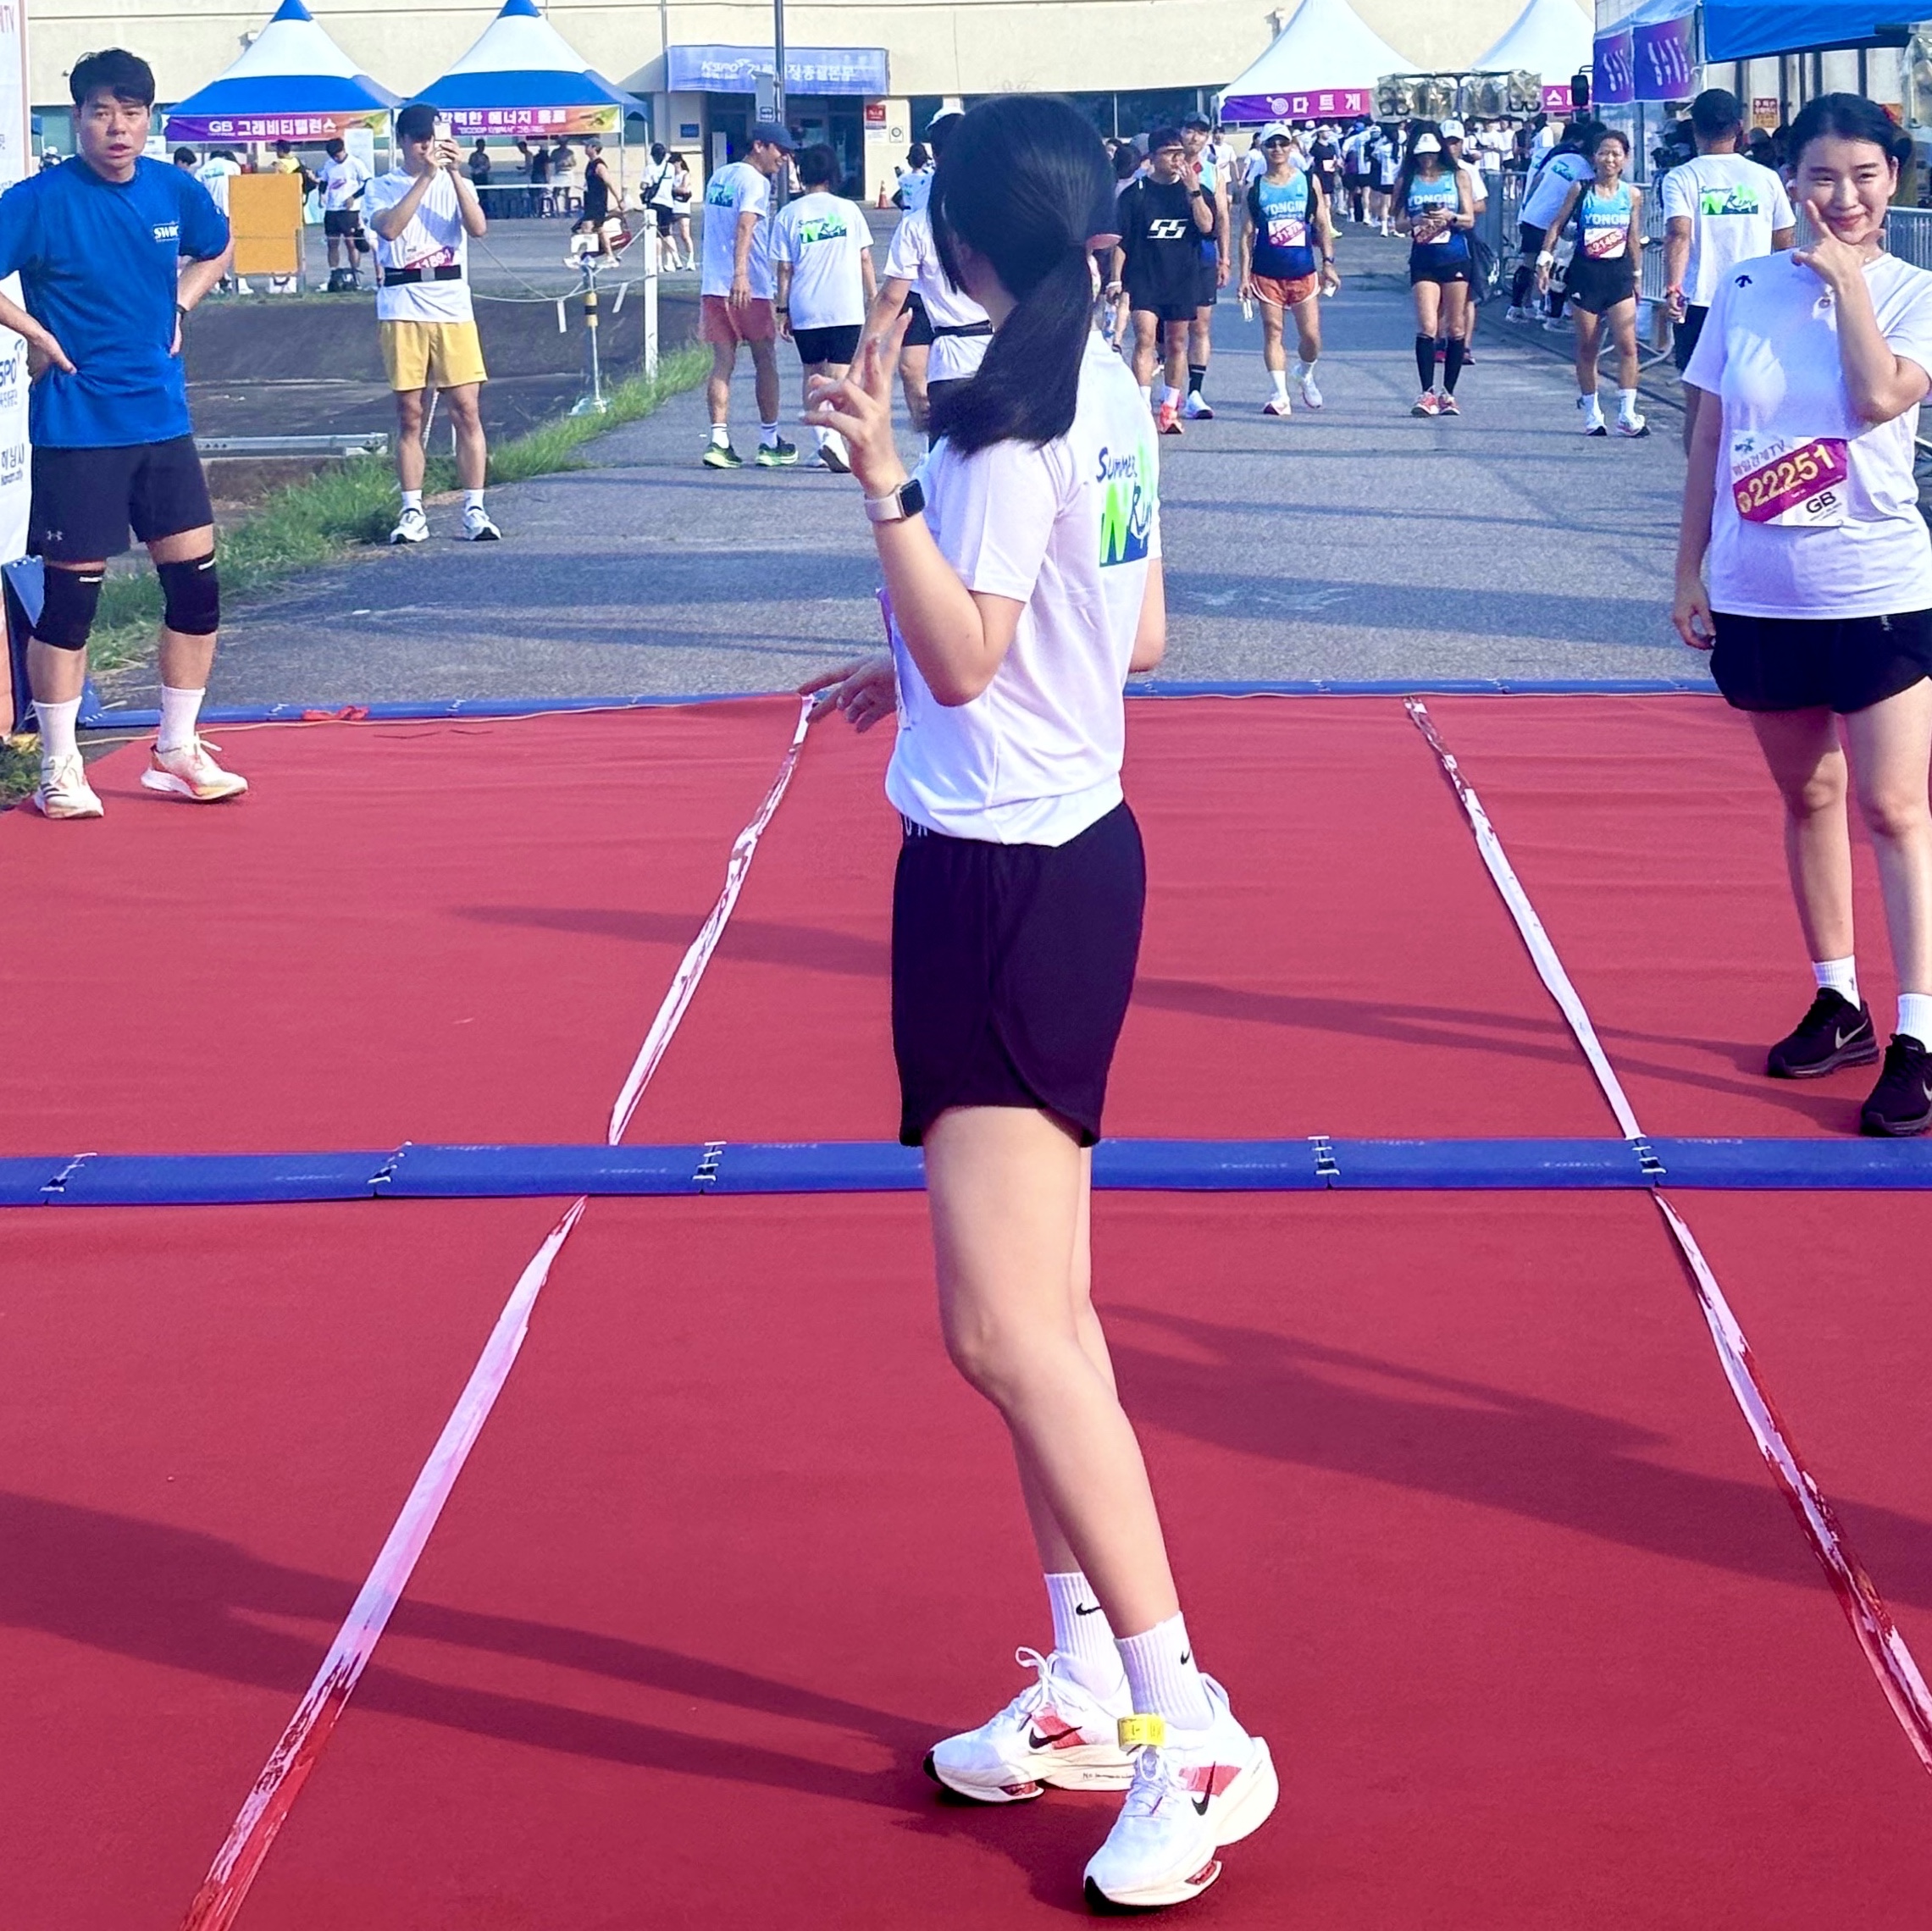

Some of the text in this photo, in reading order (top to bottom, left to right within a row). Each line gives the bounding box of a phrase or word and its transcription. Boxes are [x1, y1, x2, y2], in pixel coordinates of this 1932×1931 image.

[208, 118, 337, 136] GB 그래비티밸런스
[1748, 443, 1835, 507] 22251
[1806, 491, 1837, 513] GB
